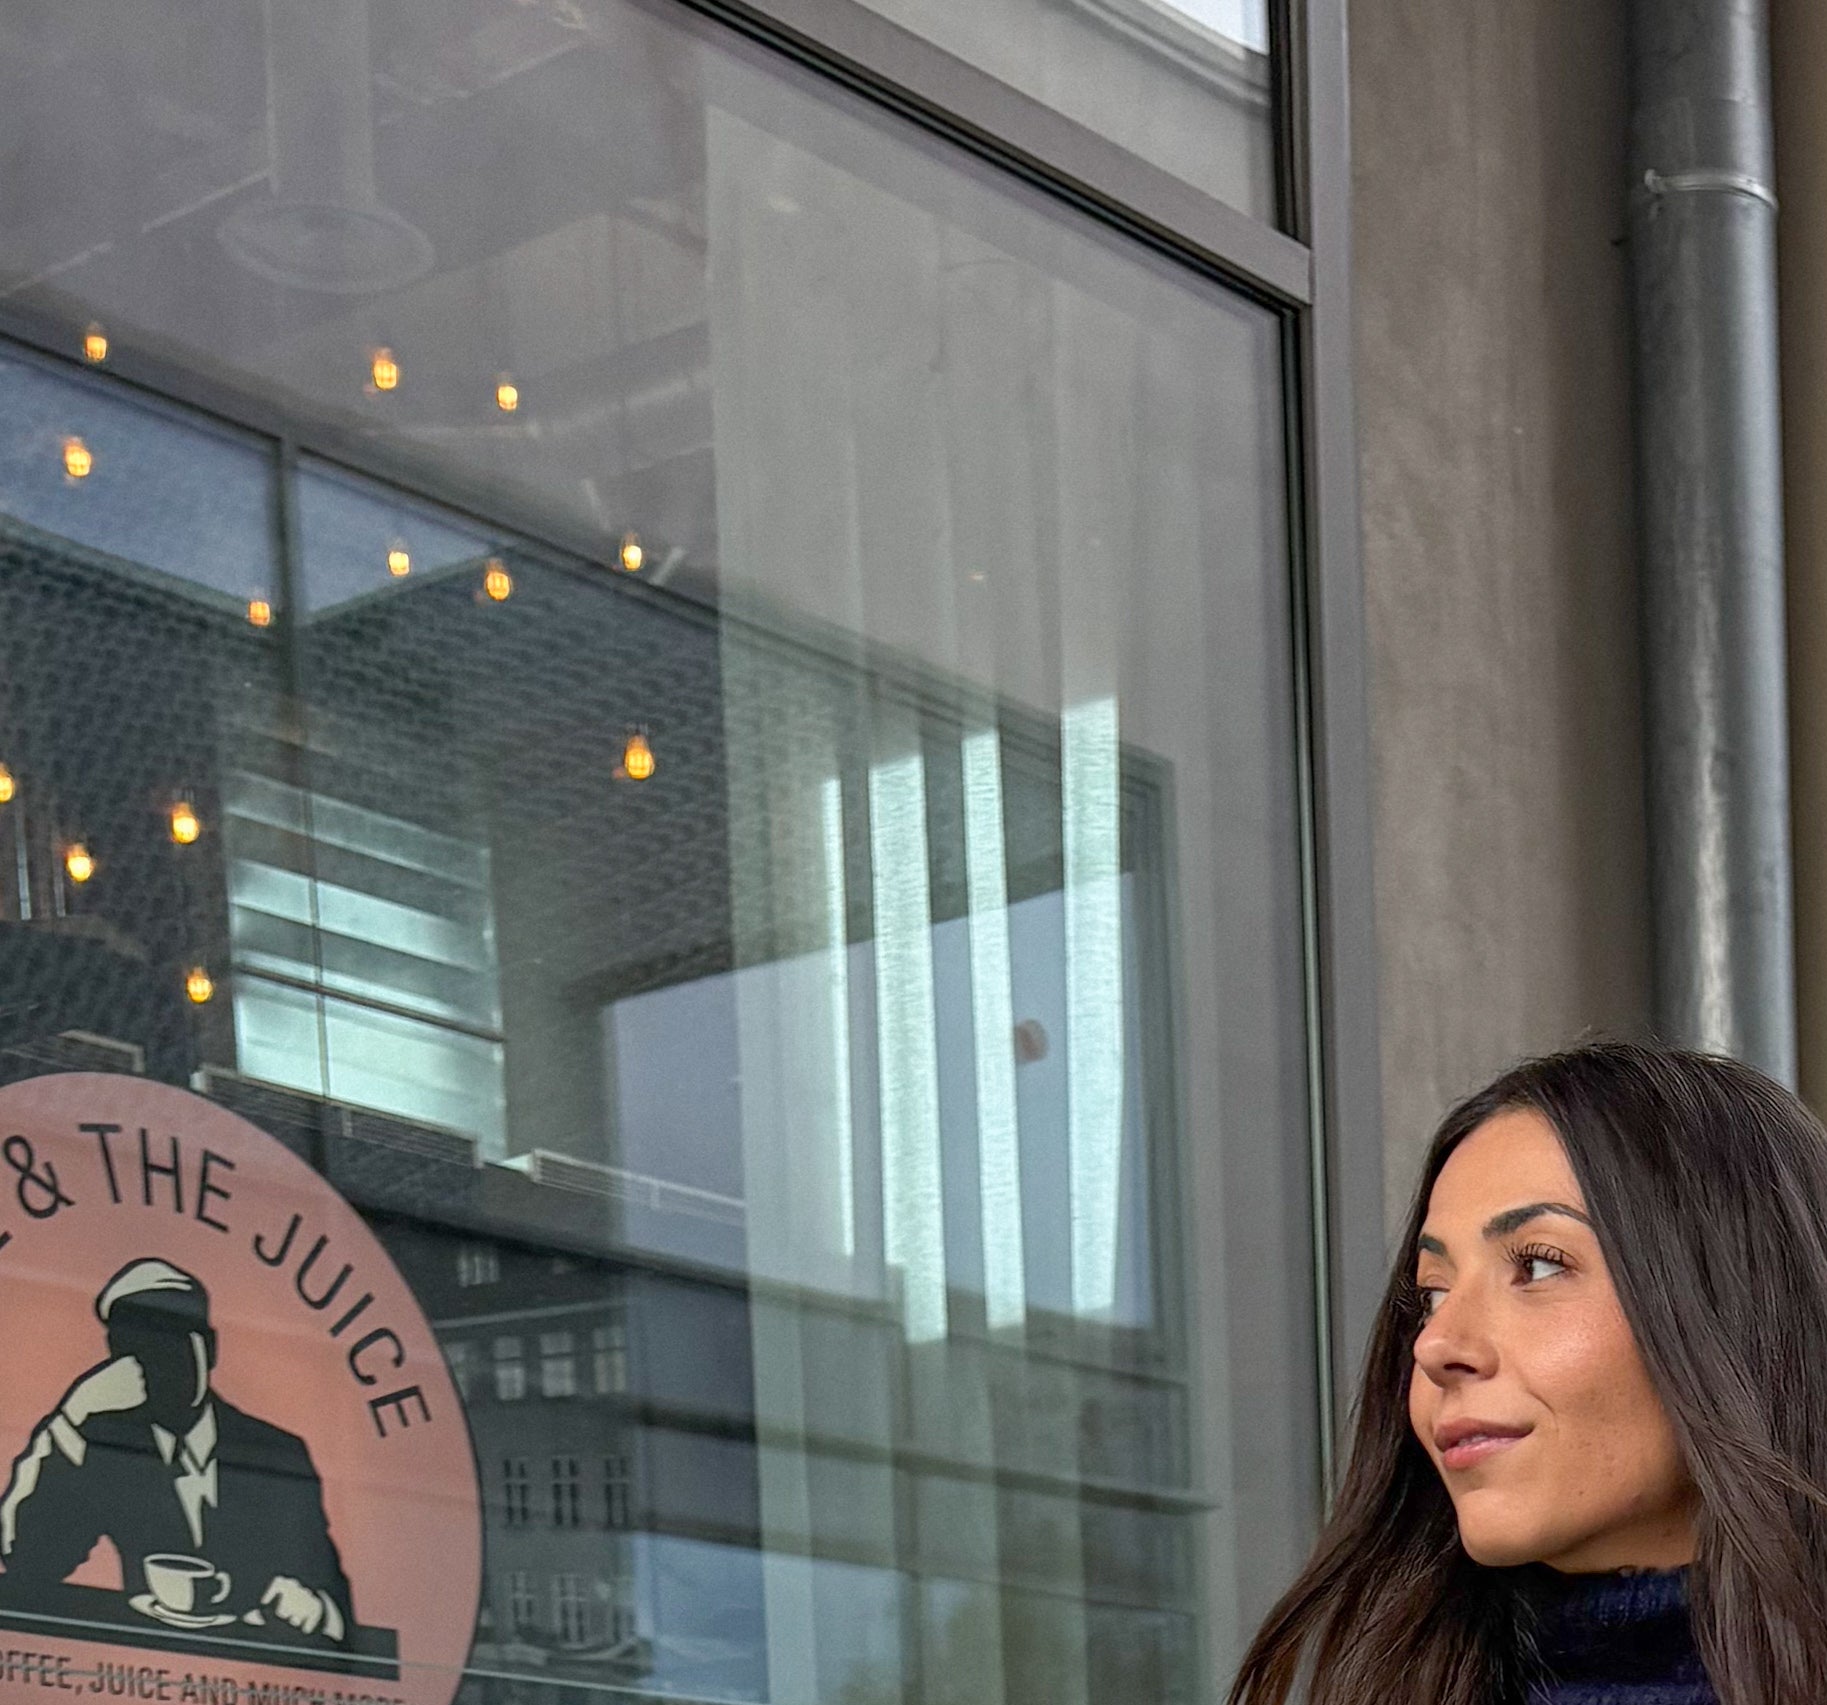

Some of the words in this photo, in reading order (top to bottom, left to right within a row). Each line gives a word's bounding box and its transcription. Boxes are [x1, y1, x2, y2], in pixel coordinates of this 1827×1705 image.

[3, 1134, 76, 1219] &
[78, 1122, 236, 1233] THE
[254, 1212, 433, 1438] JUICE
[89, 1661, 172, 1702] JUICE
